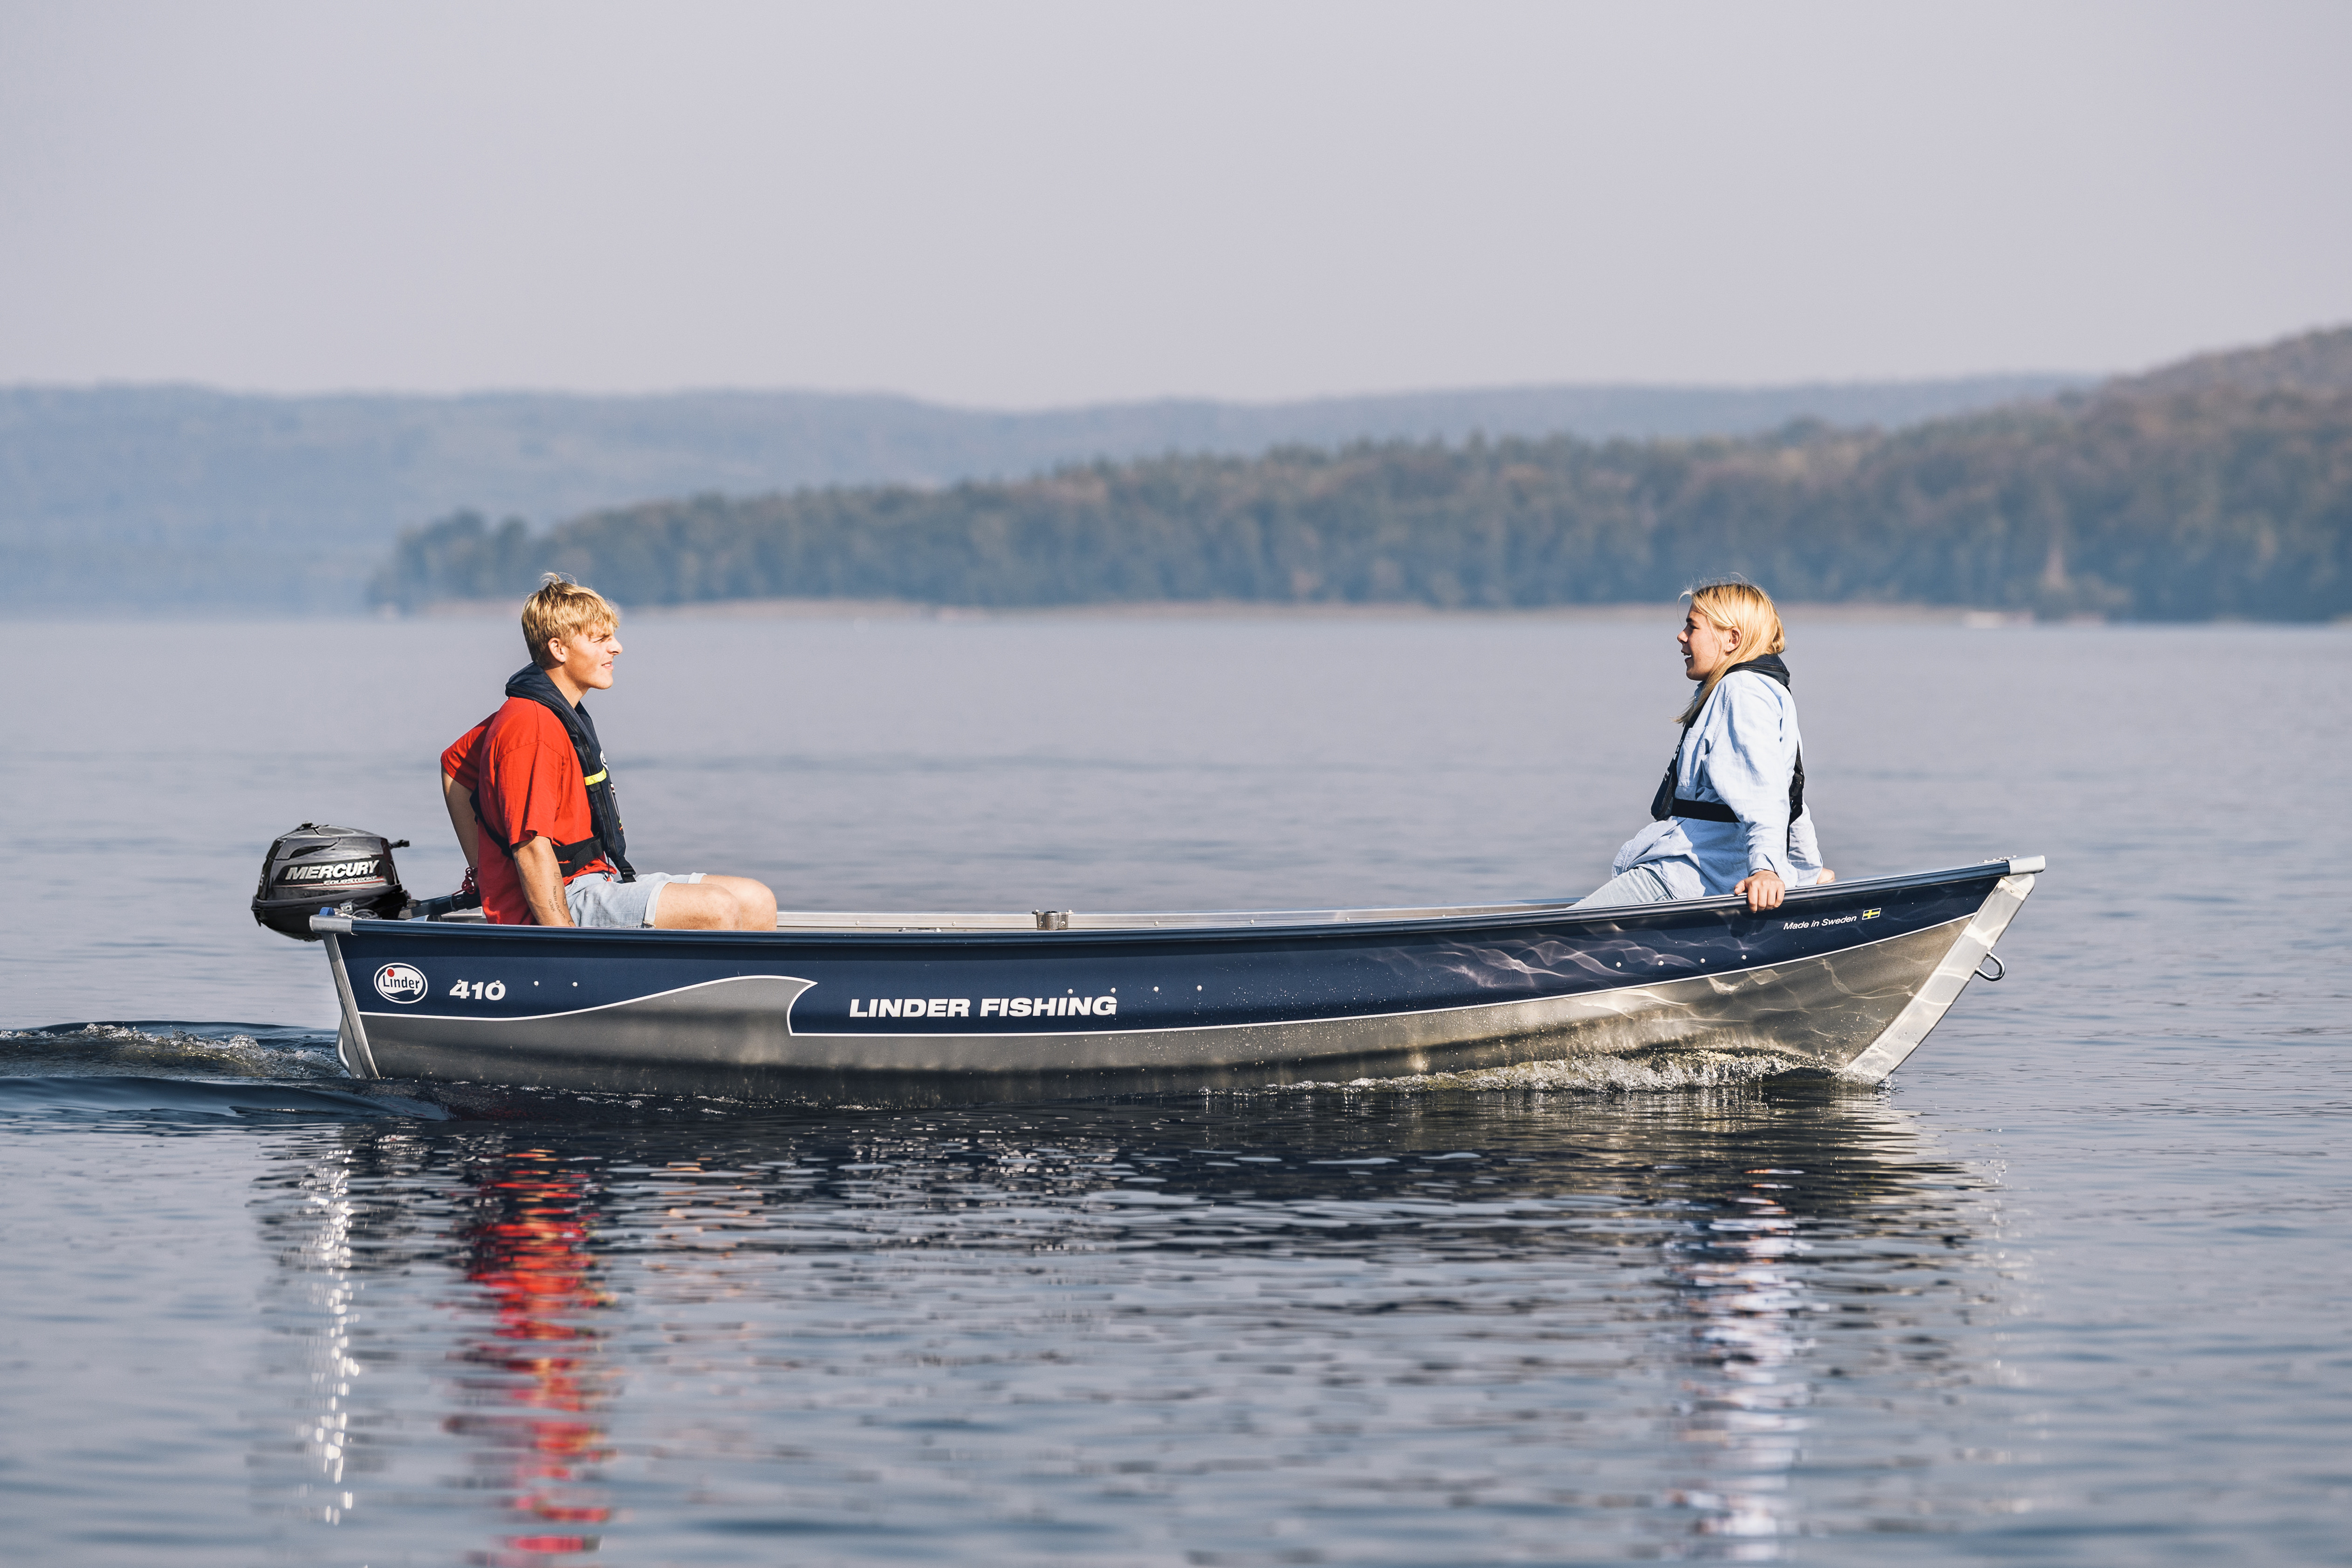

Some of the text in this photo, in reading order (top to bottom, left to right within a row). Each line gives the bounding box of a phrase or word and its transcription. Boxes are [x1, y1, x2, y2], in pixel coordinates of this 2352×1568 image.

[285, 859, 380, 880] MERCURY
[1783, 921, 1810, 930] Made
[1821, 916, 1857, 926] Sweden
[383, 974, 420, 989] Linder
[449, 981, 506, 1000] 410
[850, 996, 1118, 1017] LINDER FISHING
